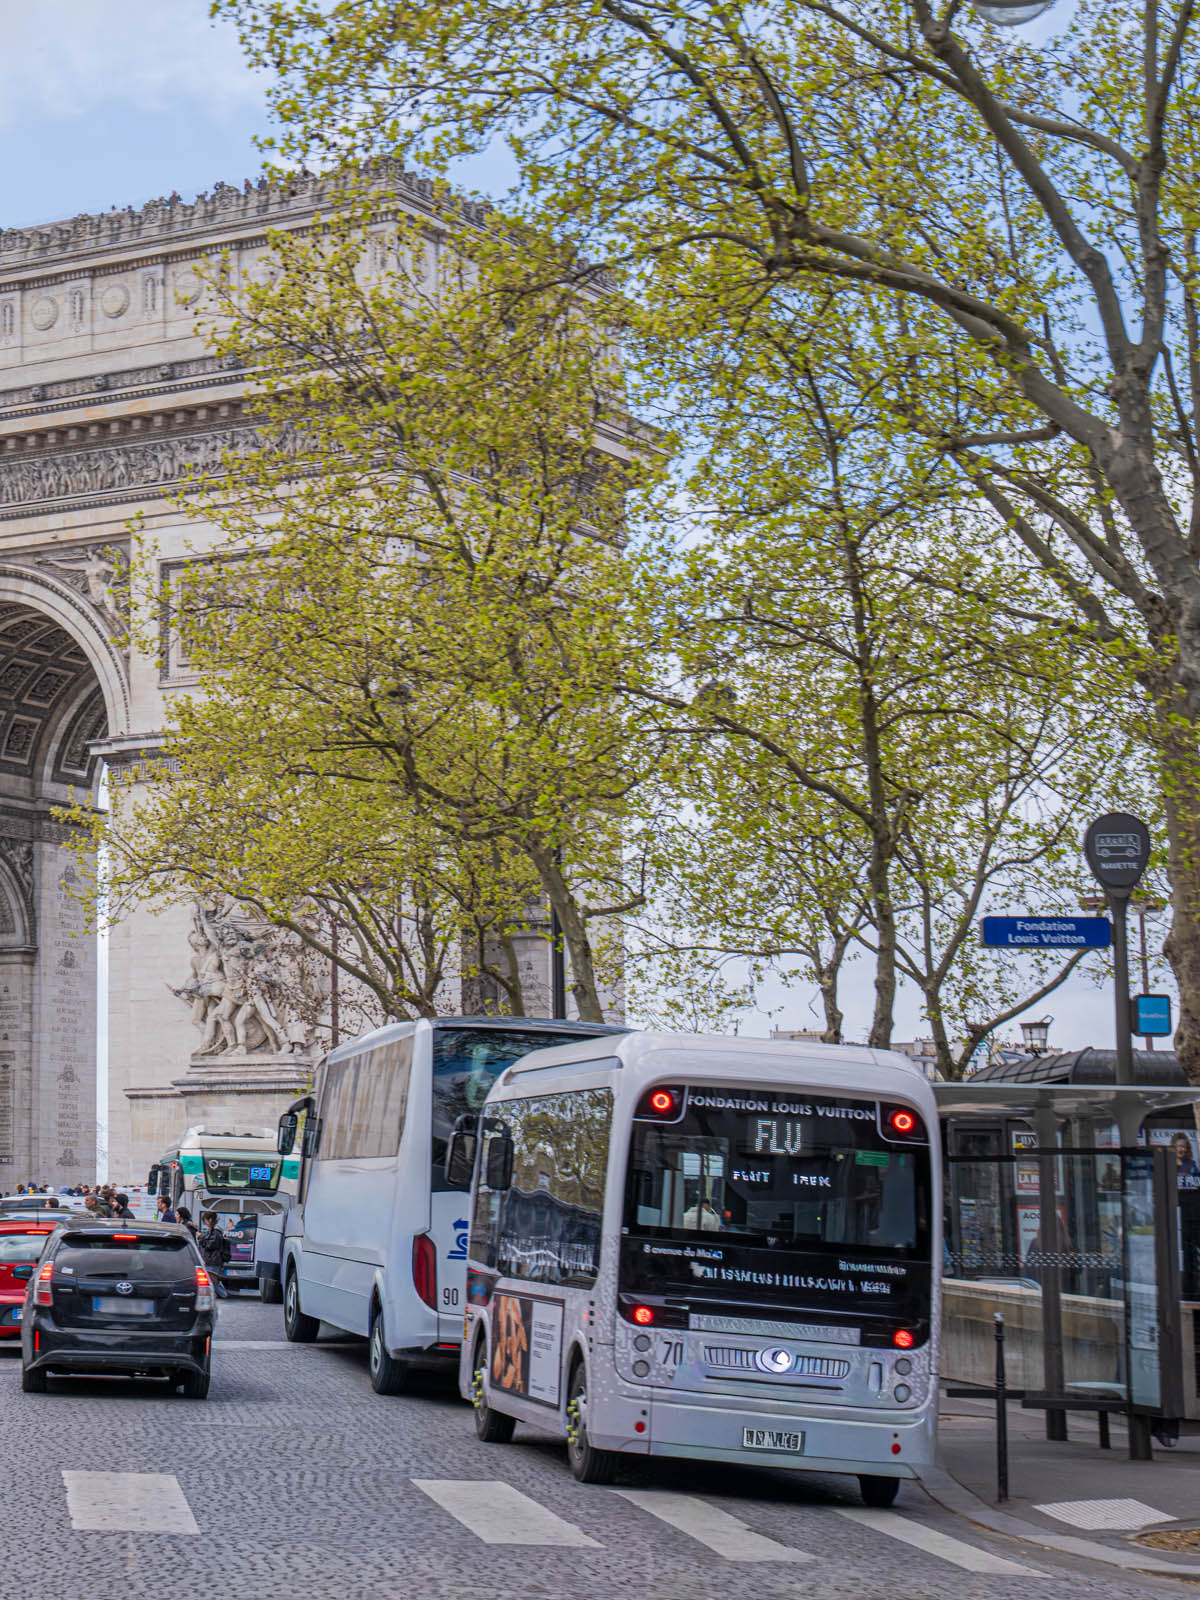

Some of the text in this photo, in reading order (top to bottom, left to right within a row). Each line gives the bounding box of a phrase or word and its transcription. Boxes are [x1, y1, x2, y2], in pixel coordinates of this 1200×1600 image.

[1100, 862, 1140, 870] NAVETTE
[1016, 921, 1076, 931] Fondation
[1008, 934, 1086, 944] Louis Vuitton
[687, 1095, 877, 1121] FONDATION LOUIS VUITTON
[253, 1168, 269, 1179] 52
[651, 1246, 682, 1256] avenue
[683, 1246, 696, 1257] du
[443, 1287, 459, 1305] 90
[664, 1342, 684, 1365] 70
